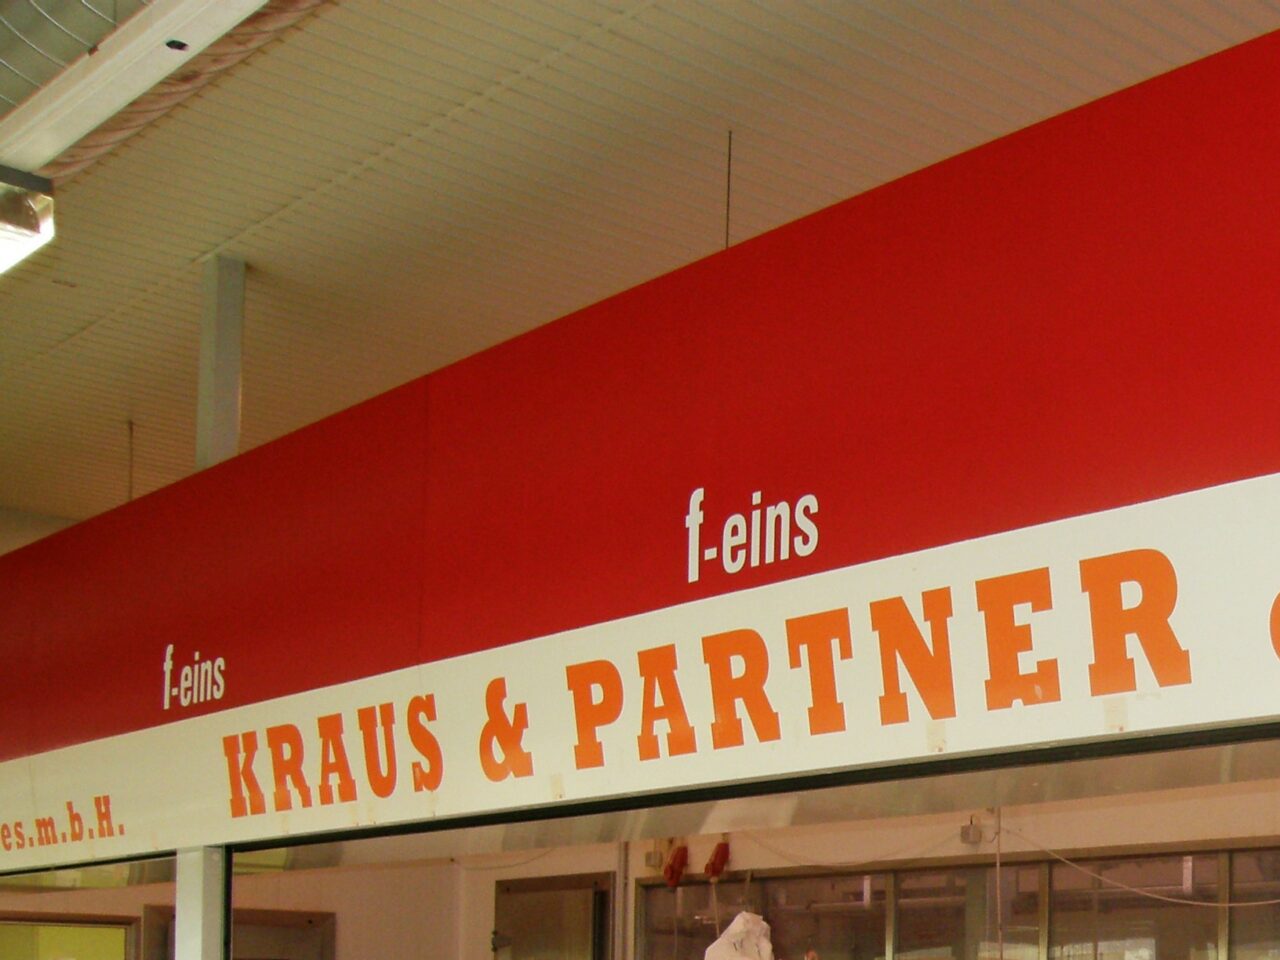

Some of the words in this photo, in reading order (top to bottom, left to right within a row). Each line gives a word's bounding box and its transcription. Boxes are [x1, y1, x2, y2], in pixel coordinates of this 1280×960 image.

[685, 487, 819, 583] f-eins
[163, 644, 225, 709] f-eins
[221, 693, 444, 819] KRAUS
[478, 677, 533, 782] &
[565, 548, 1192, 770] PARTNER
